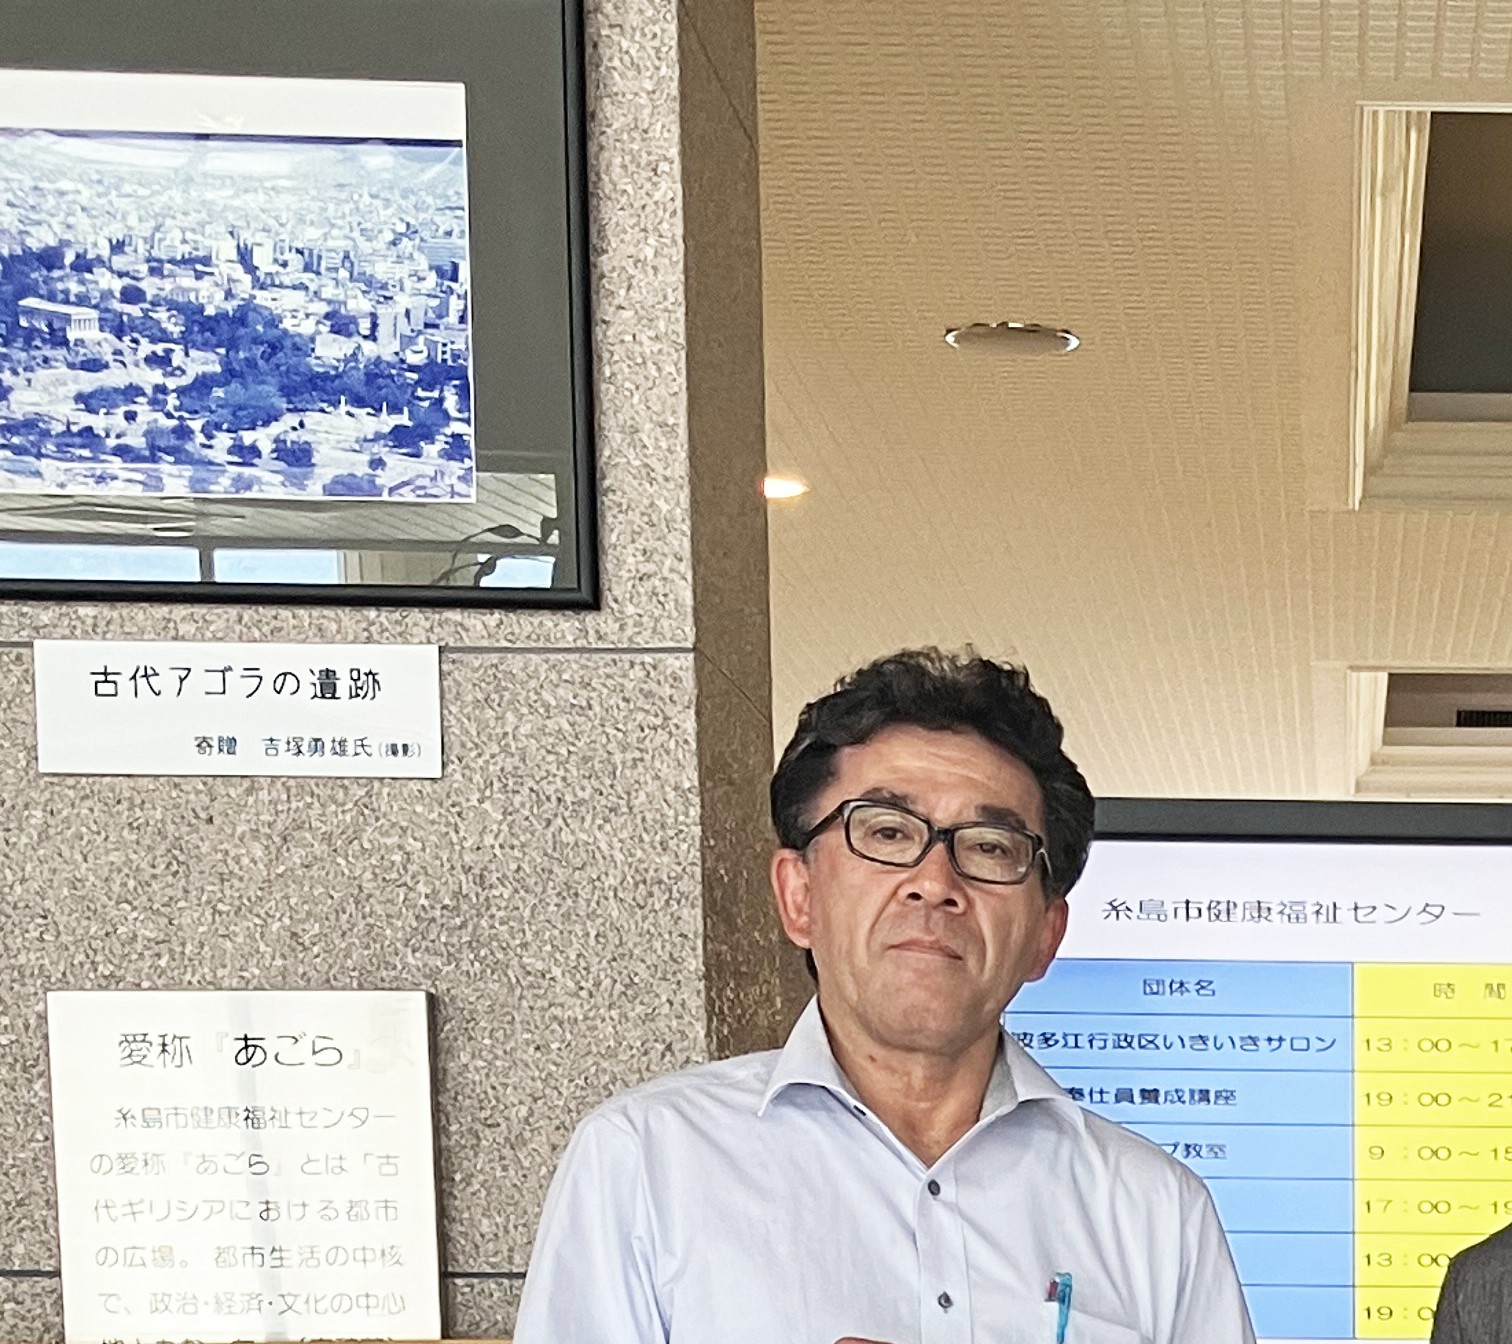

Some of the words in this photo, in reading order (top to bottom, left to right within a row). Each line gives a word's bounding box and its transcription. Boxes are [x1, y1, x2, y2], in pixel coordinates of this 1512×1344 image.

[89, 664, 382, 701] 古代アゴラの遺跡
[1101, 897, 1481, 926] 糸島市健康福祉センター
[1142, 978, 1216, 998] 団体名
[113, 1105, 397, 1131] 糸島市健康福祉センター
[94, 1199, 399, 1223] 代ギリシアにおける都市
